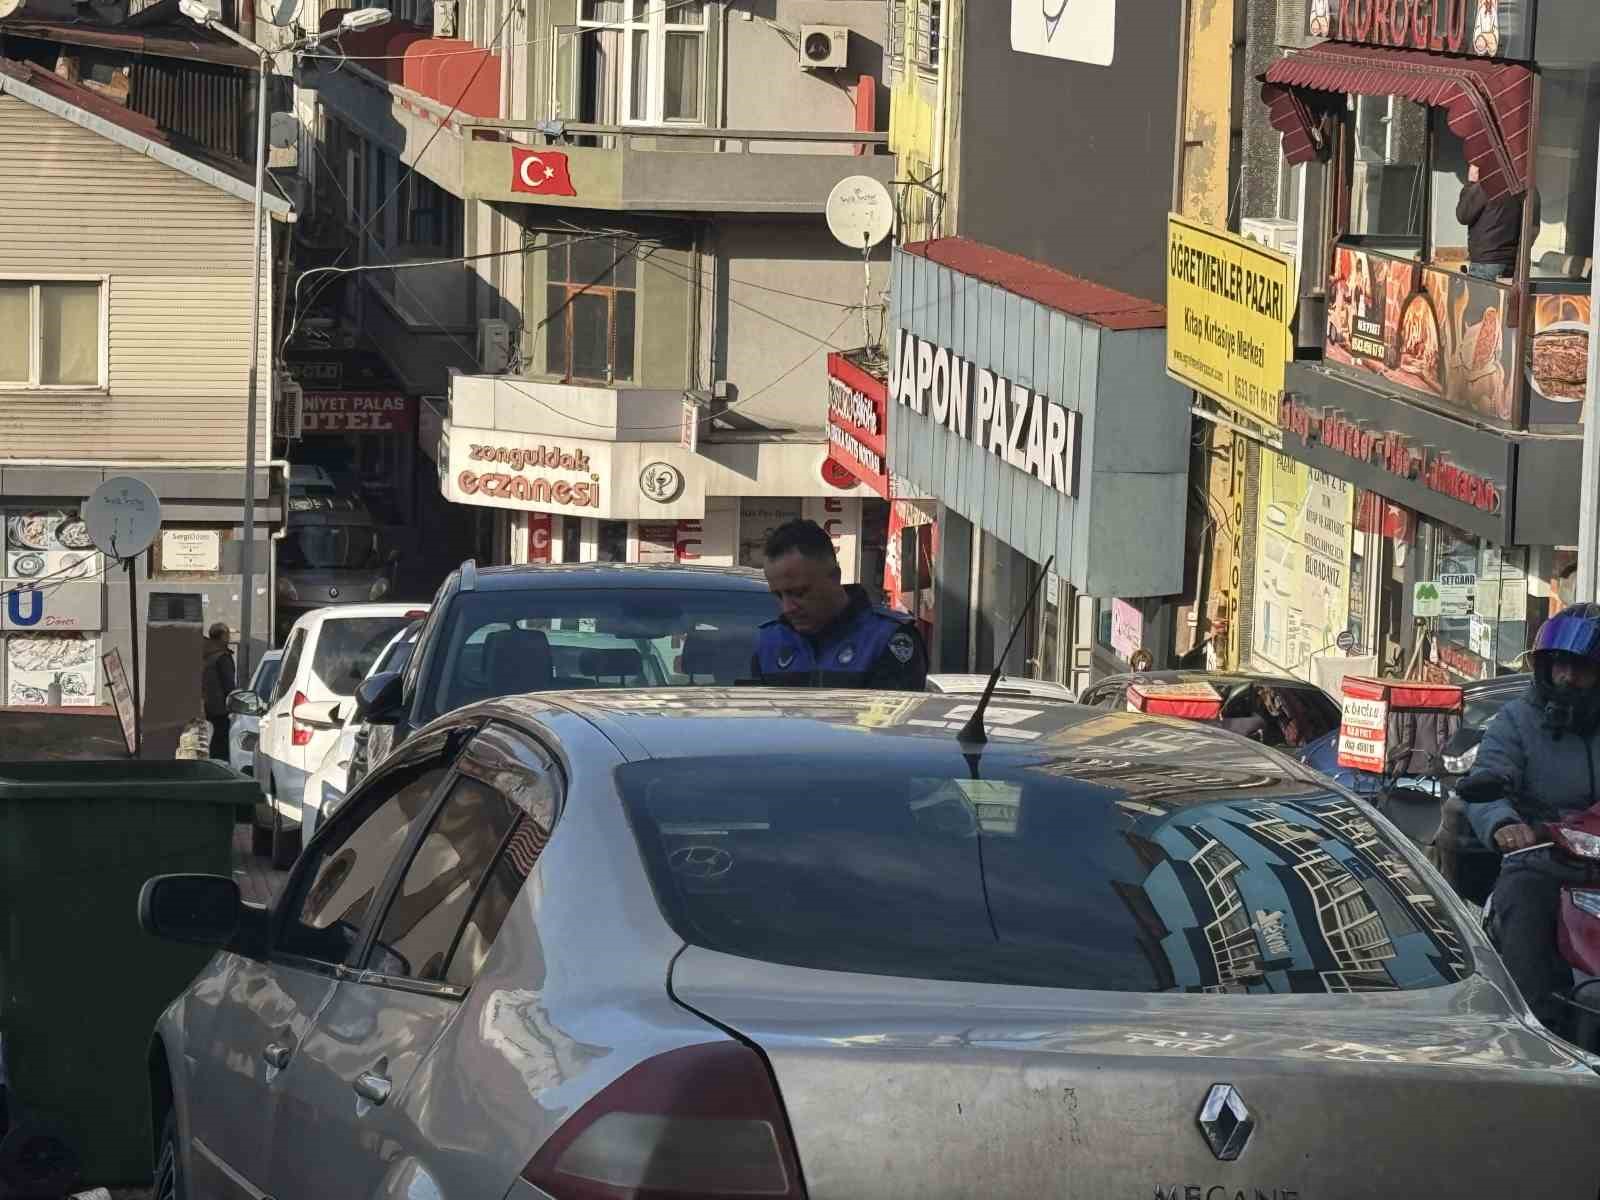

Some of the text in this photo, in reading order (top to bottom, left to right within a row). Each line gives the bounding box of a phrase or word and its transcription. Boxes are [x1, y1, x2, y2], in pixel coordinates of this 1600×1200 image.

[1246, 269, 1284, 324] PAZARI
[1184, 305, 1203, 345] Kitap
[1237, 329, 1265, 369] Merkezi
[353, 396, 406, 411] PALAS
[888, 327, 1079, 498] JAPON PAZARI
[469, 444, 592, 473] zonguldak
[458, 469, 600, 509] eczanesi
[1305, 554, 1341, 587] BURADAYIZ
